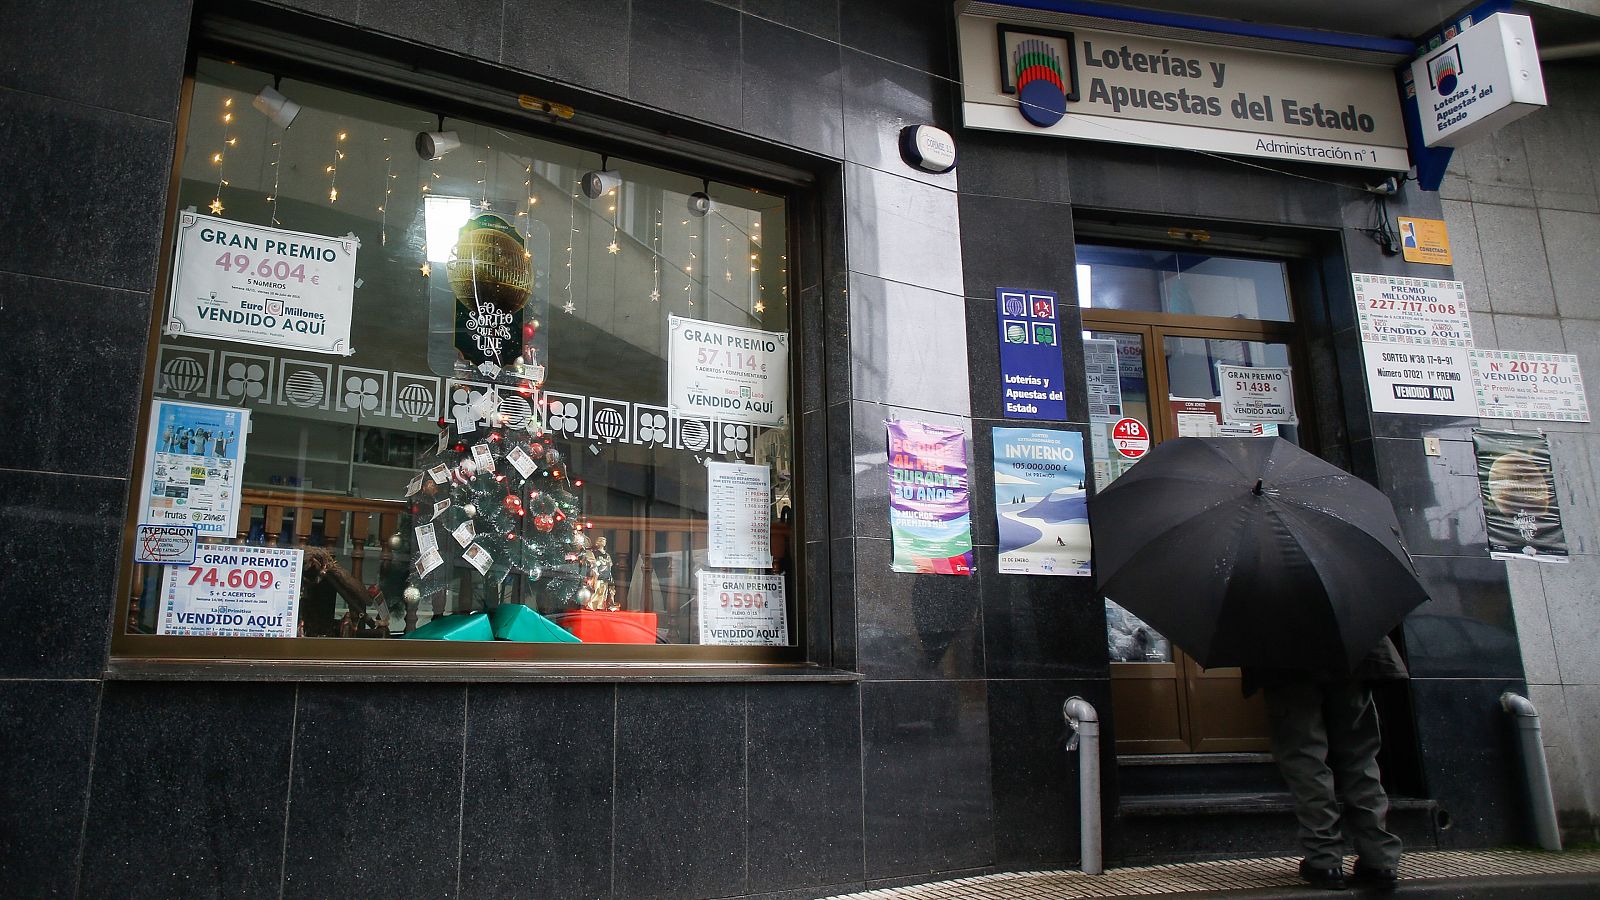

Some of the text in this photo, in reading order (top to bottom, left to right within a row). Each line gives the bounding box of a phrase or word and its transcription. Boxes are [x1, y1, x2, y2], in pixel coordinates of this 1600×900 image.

[1084, 41, 1226, 88] Loterías y
[1434, 84, 1477, 111] Loterías y
[1437, 86, 1493, 121] Apuestas del
[1090, 78, 1375, 133] Apuestas del Estado
[1438, 112, 1467, 131] Estado
[1256, 139, 1353, 162] Administración
[1371, 150, 1377, 162] 1
[200, 229, 336, 263] GRAN PREMIO
[216, 252, 320, 285] 49.604 €
[1391, 286, 1425, 294] PREMIO
[1382, 293, 1437, 303] MILLONARIO
[241, 301, 263, 311] Euro
[285, 307, 324, 320] Millones
[1369, 299, 1456, 314] 227.717.008
[198, 306, 276, 328] VENDIDO
[282, 319, 326, 335] AQUÍ
[466, 310, 513, 330] SORTEO
[477, 324, 512, 340] QUE NOS
[1374, 327, 1426, 335] VENDIDO
[472, 334, 503, 357] UNE
[684, 329, 776, 352] GRAN PREMIO
[698, 348, 766, 372] 57.114 €
[1382, 353, 1408, 363] SORTEO
[1427, 355, 1453, 365] 17-8-91
[1377, 368, 1402, 378] Número
[1404, 370, 1423, 379] 07021
[1437, 371, 1461, 381] PREMIO
[1509, 361, 1558, 374] 20737
[1005, 374, 1049, 388] Loterías y
[1482, 372, 1571, 385] VENDIDO AQUI
[1236, 382, 1270, 392] 51.438
[1395, 385, 1452, 400] VENDIDO AQUI
[1533, 384, 1538, 393] 3
[1006, 389, 1063, 401] Apuestas del
[687, 394, 773, 413] VENDIDO AQUÍ
[1007, 403, 1038, 414] Estado
[1120, 422, 1140, 435] +18
[1006, 444, 1074, 461] INVIERNO
[894, 454, 913, 469] AL
[1013, 462, 1061, 471] 105.000.000
[894, 469, 961, 487] DURANTE
[895, 486, 914, 500] 30
[165, 511, 187, 520] frutas
[141, 527, 193, 536] ATENCION
[204, 555, 288, 567] GRAN PREMIO
[188, 567, 281, 589] 74.609 €
[722, 582, 777, 591] GRAN PREMIO
[720, 592, 763, 608] 9.590
[177, 613, 282, 628] VENDIDO AQUÍ
[711, 627, 779, 640] VENDIDO AQUÍ
